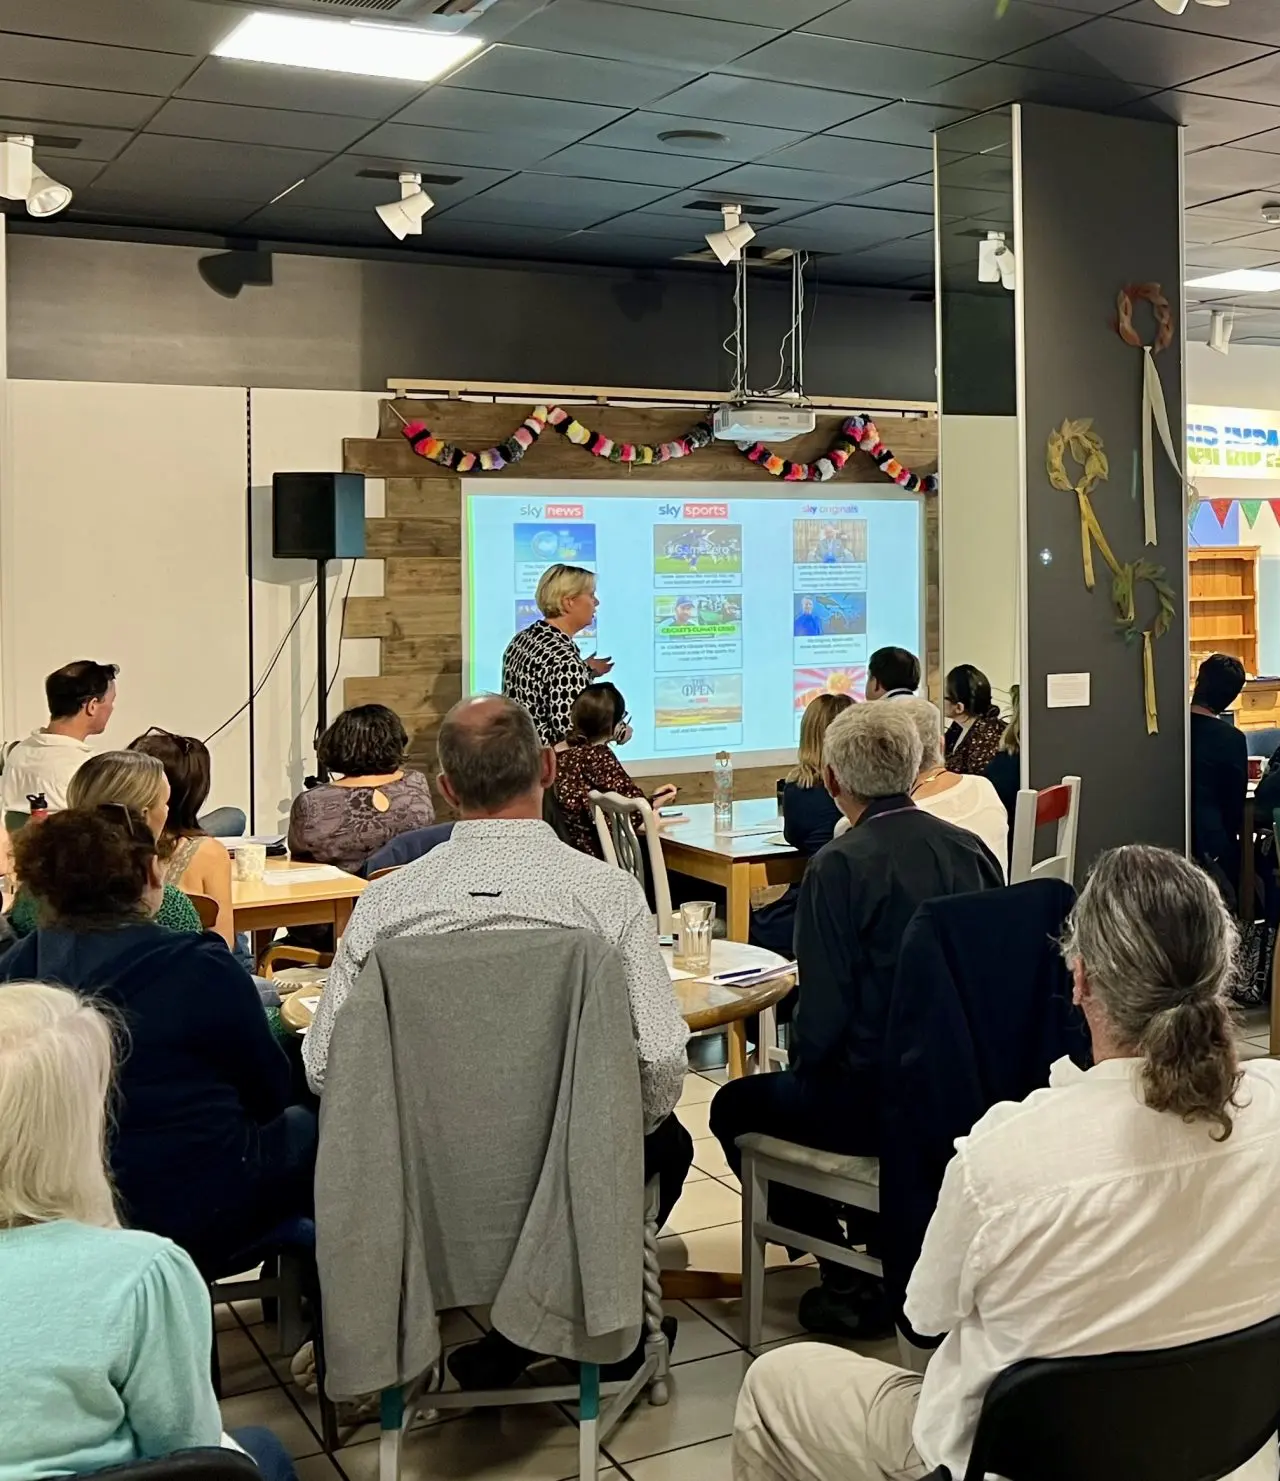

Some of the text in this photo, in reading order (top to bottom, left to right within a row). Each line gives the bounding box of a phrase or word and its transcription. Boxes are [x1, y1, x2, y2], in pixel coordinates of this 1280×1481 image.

[520, 503, 582, 518] sky news
[658, 503, 726, 518] sky sports
[802, 503, 817, 515] sky
[682, 684, 715, 697] OPEN
